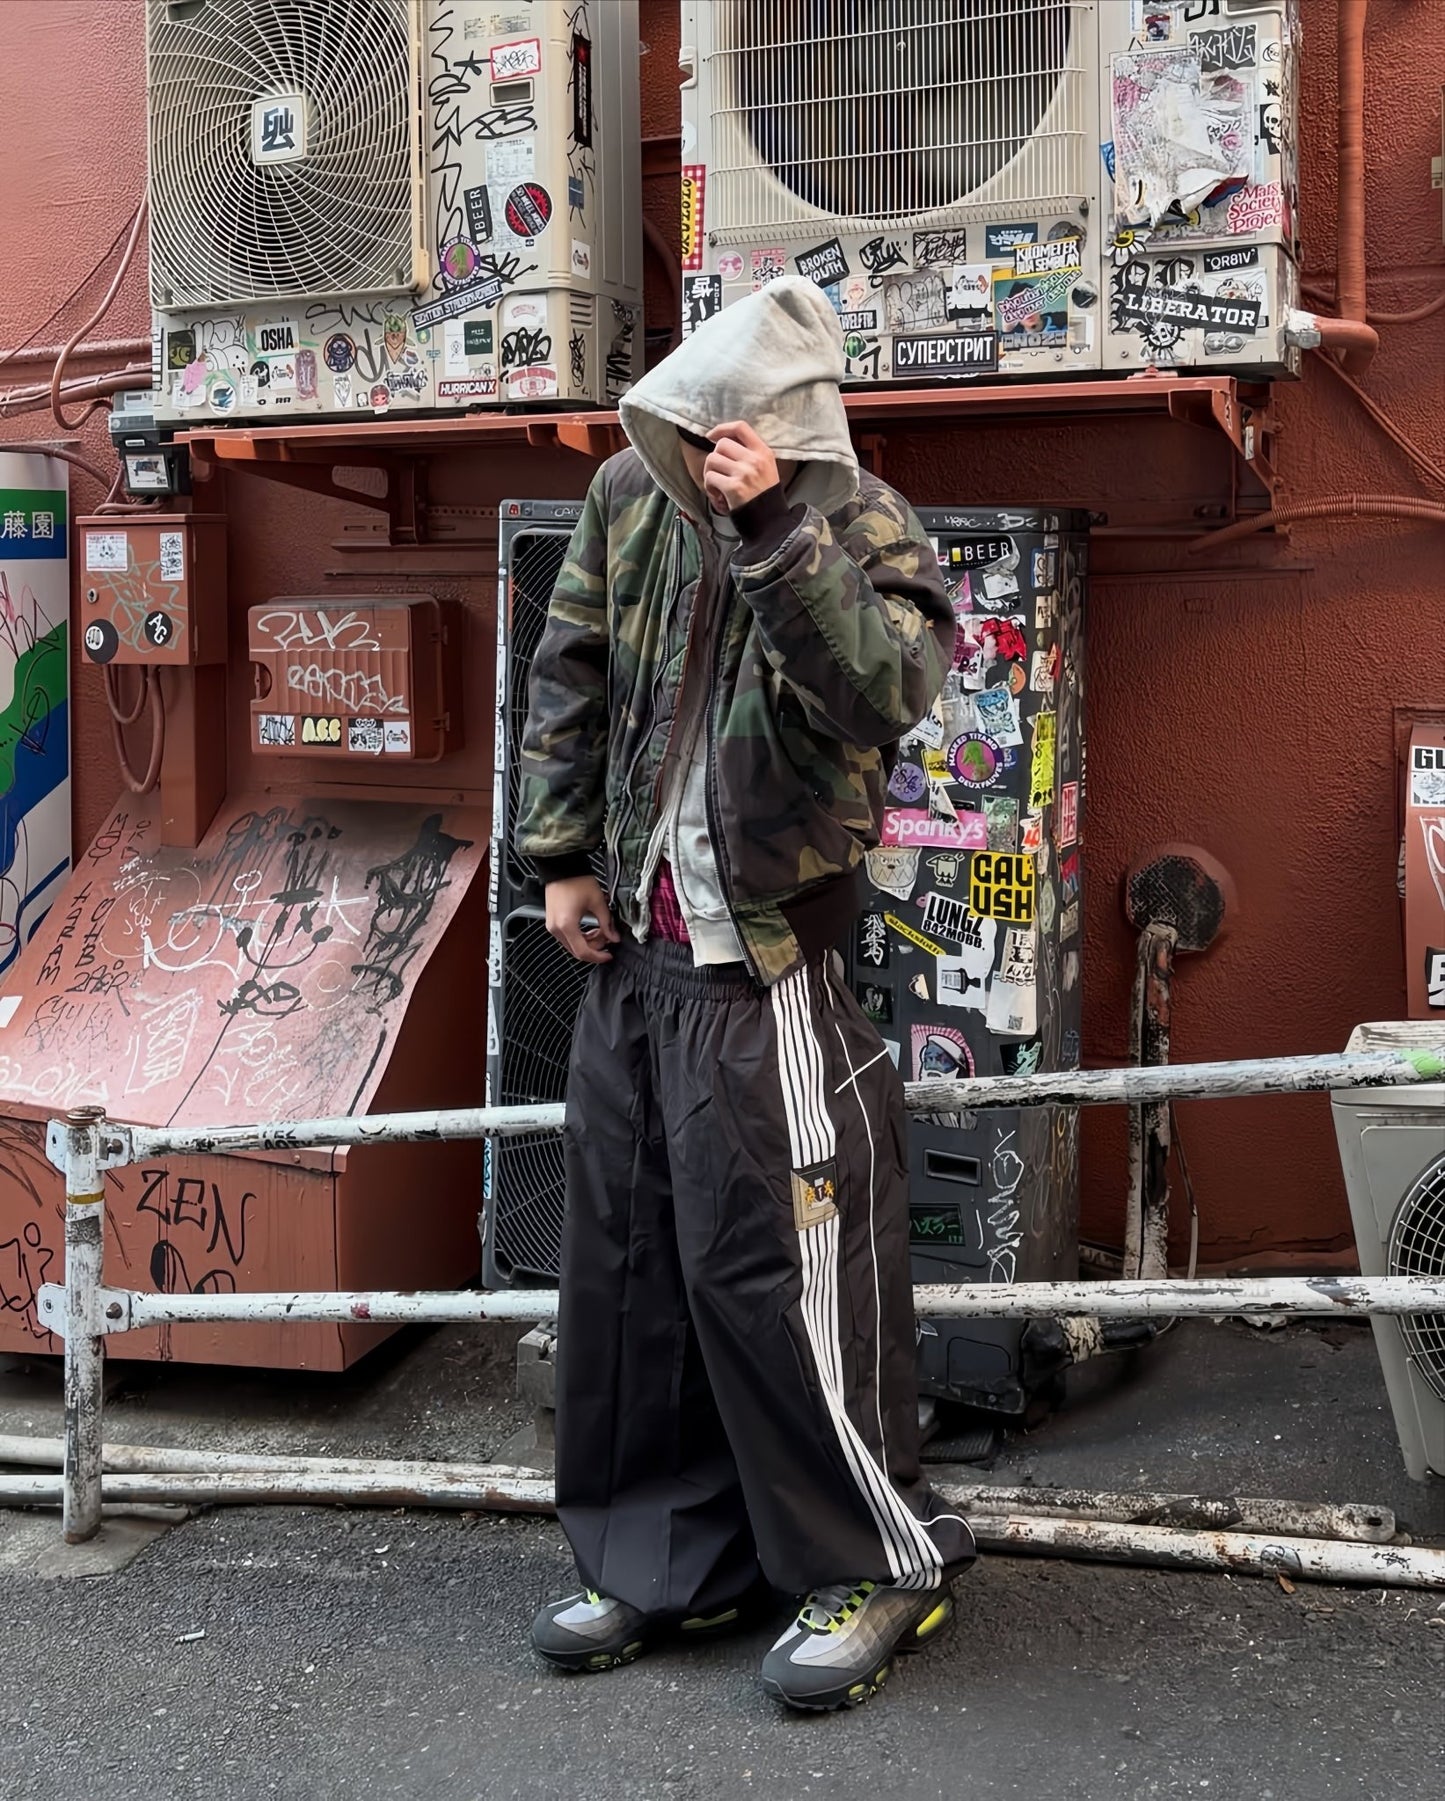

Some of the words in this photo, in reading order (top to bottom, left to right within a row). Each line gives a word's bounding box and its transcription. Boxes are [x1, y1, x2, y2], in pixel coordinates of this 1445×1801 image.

[470, 189, 486, 230] BEER
[800, 243, 841, 273] BROKEN
[1016, 240, 1077, 262] KILOMETER
[1126, 294, 1256, 327] LIBERATOR
[261, 327, 294, 351] OSHA
[897, 337, 993, 366] СУПЕРСТРИТ
[1, 511, 54, 539] 藤園
[964, 542, 1009, 561] BEER
[949, 735, 967, 767] MASKED
[886, 812, 984, 845] Spanky's
[973, 885, 1032, 920] USH
